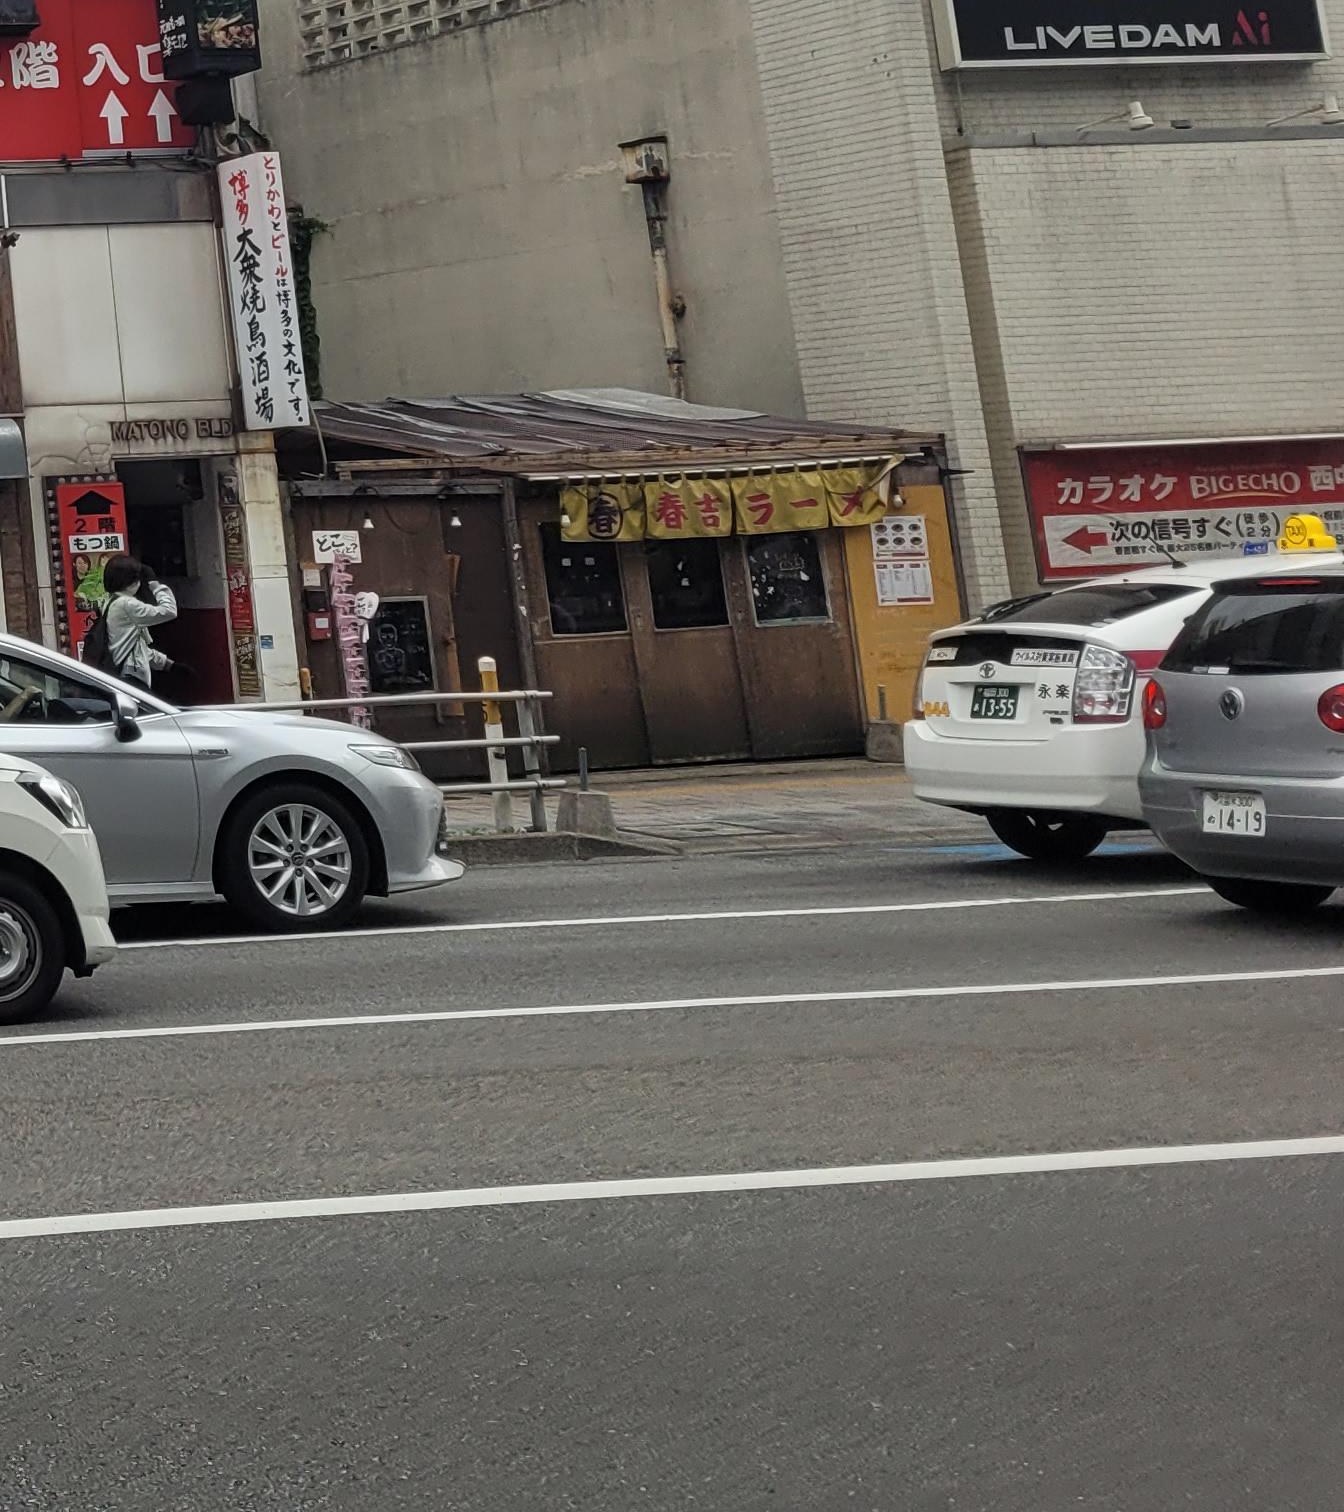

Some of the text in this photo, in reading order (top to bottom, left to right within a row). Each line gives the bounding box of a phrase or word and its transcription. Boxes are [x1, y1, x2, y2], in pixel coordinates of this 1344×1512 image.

[108, 419, 189, 441] MATONO
[1057, 472, 1178, 506] カラオケ
[1189, 473, 1234, 500] BIG
[1238, 470, 1302, 494] ECHO
[656, 484, 887, 530] 春吉ラーメ
[1109, 516, 1233, 542] 次の信号すぐ
[73, 536, 120, 552] もつ鍋
